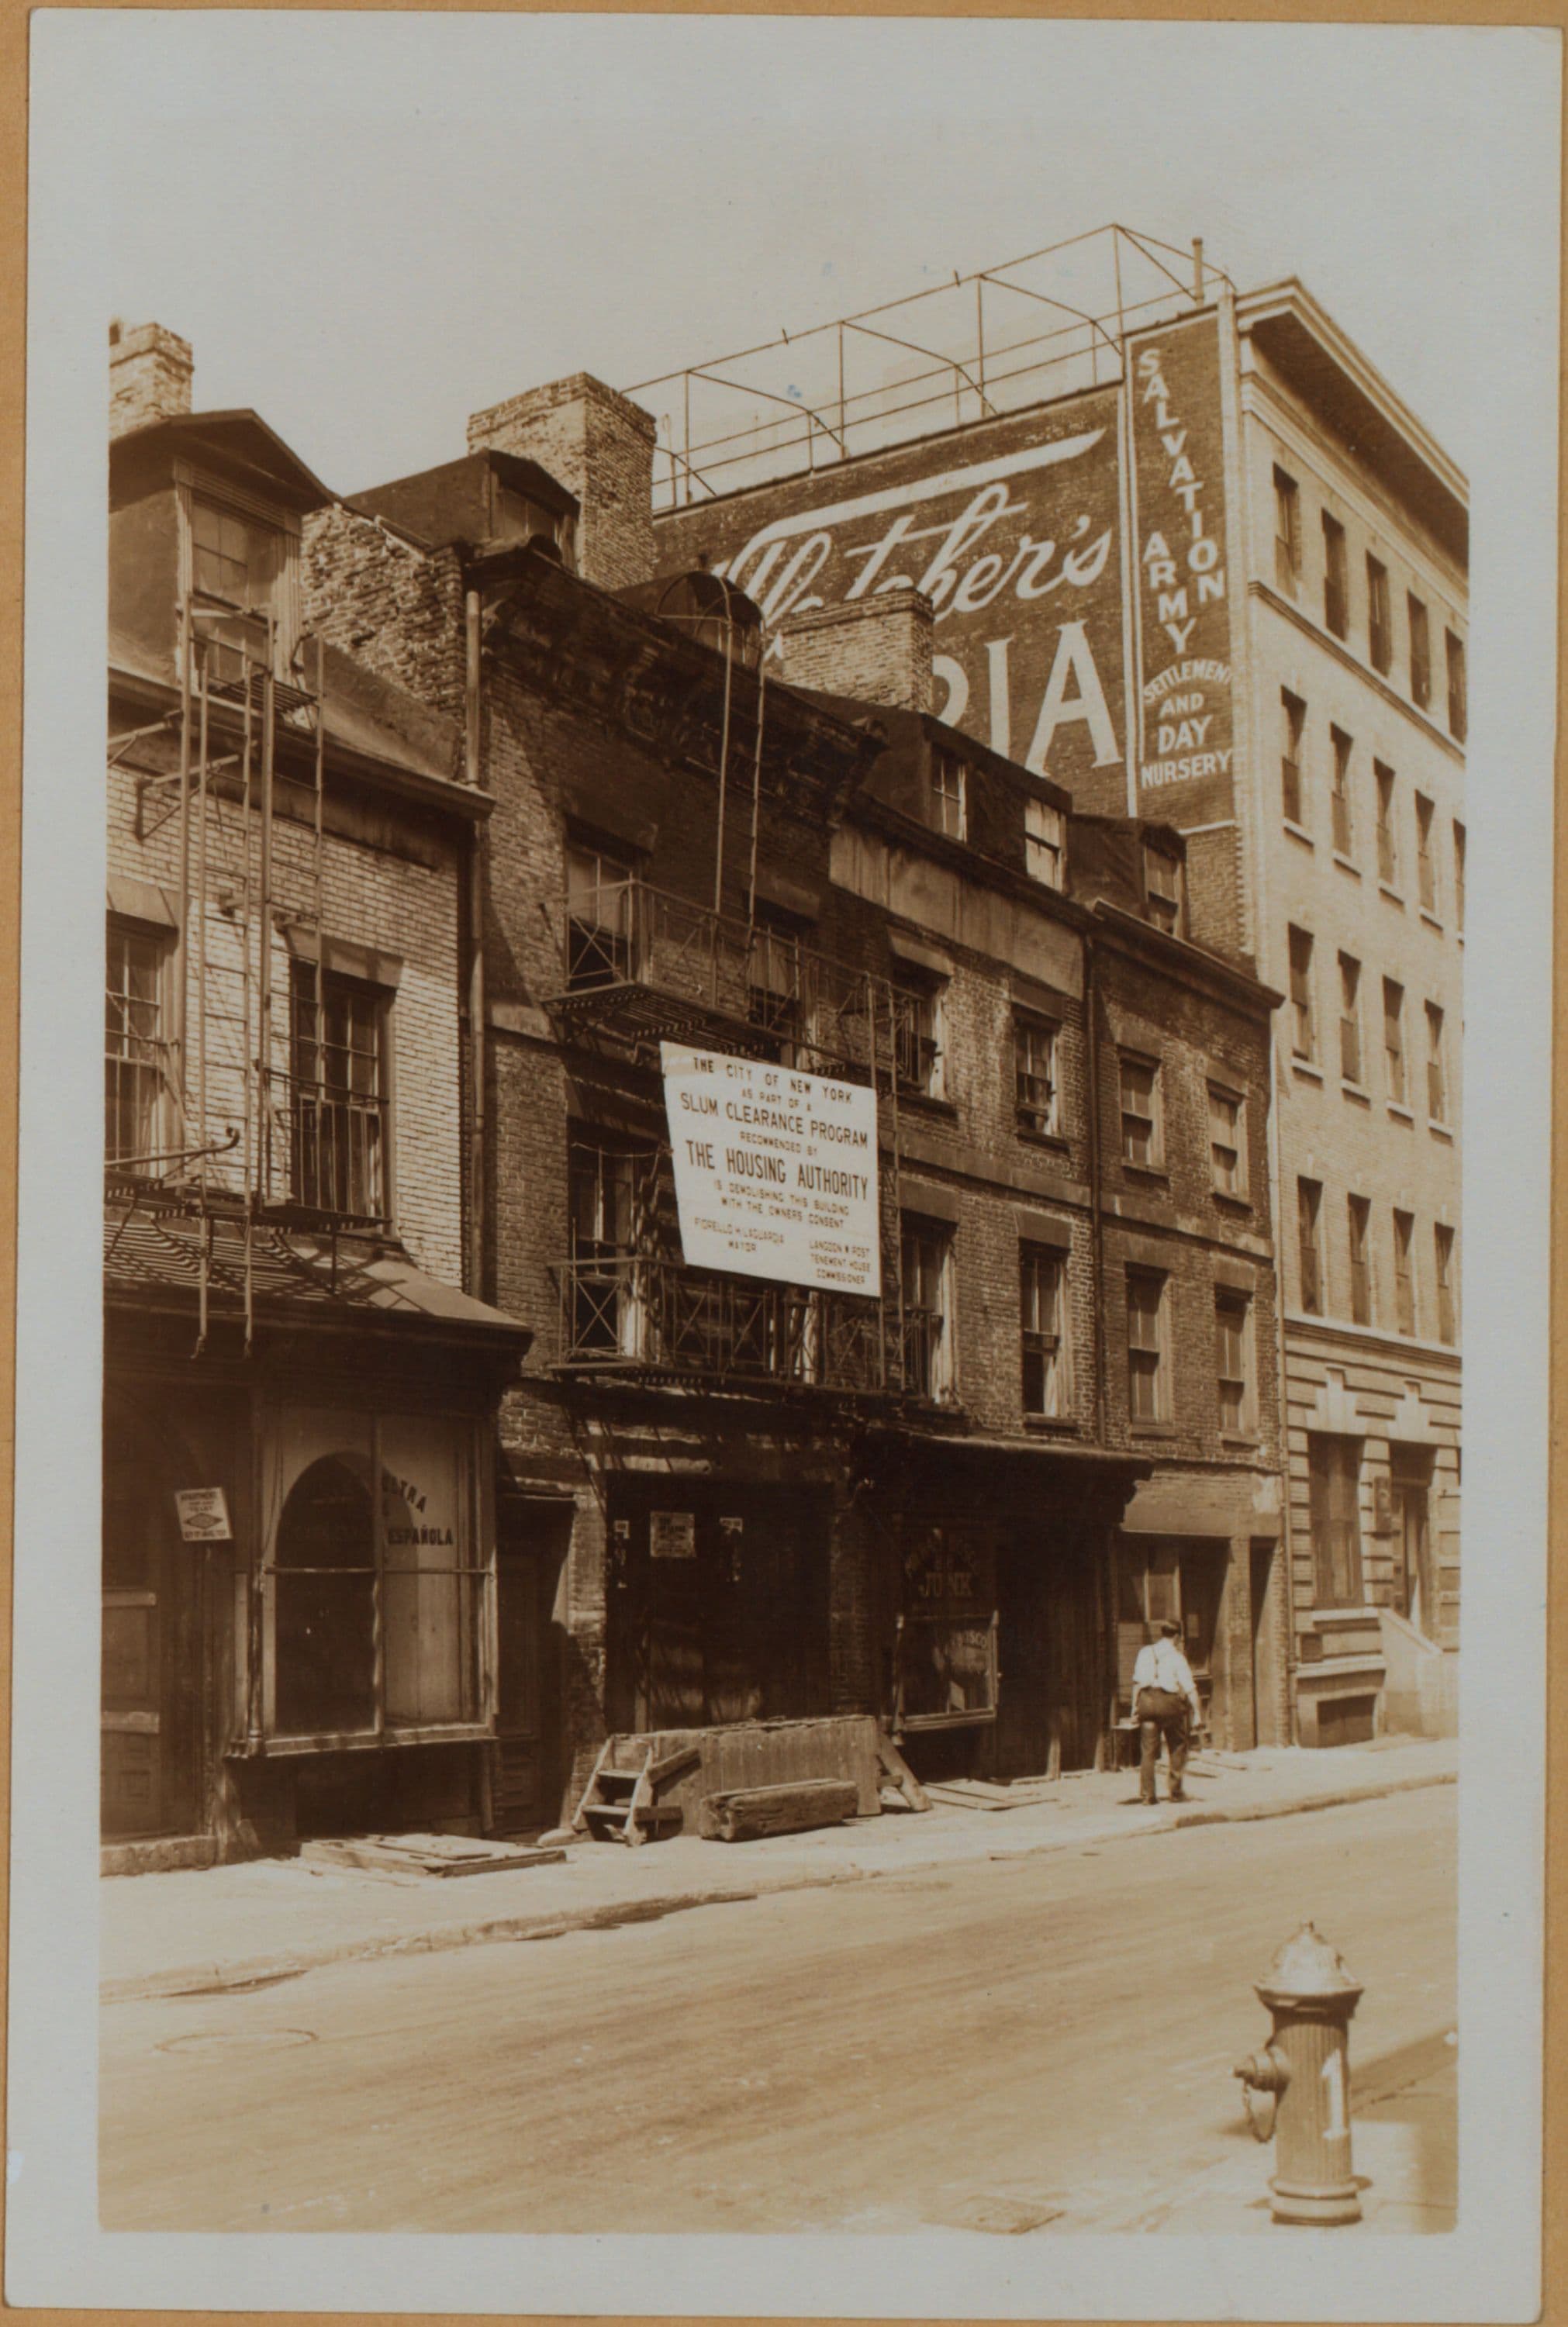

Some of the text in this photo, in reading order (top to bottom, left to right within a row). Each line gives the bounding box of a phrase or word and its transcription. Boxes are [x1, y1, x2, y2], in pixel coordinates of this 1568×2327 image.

[1138, 349, 1225, 603] SALVATION
[1142, 530, 1197, 654] ARMY
[1159, 693, 1205, 719] AND
[1158, 713, 1214, 754] DAY
[1141, 748, 1233, 789] NURSERY
[693, 1057, 852, 1105] THE CITY OF NEW YORK
[742, 1089, 753, 1100] AS
[760, 1091, 782, 1108] PART
[789, 1097, 800, 1109] OF
[680, 1093, 868, 1149] SLUM CLEARANCE PROGRAM
[740, 1131, 818, 1158] RECOMMENDED BY
[686, 1139, 869, 1201] THE HOUSING AUTHORITY
[713, 1179, 849, 1217] IS DEMOLISHING THIS BUILDING
[694, 1217, 733, 1235] FIORELLO
[721, 1197, 844, 1229] WITH THE OWNERS CONSENT
[728, 1240, 757, 1253] MAYOR
[809, 1241, 843, 1254] LANGDON
[851, 1247, 872, 1259] POST
[810, 1253, 872, 1272] TENEMENT HOUSE
[817, 1269, 865, 1286] COMMISSIONER
[388, 1522, 453, 1545] ESPAÑOLA
[918, 1573, 973, 1598] JUNK
